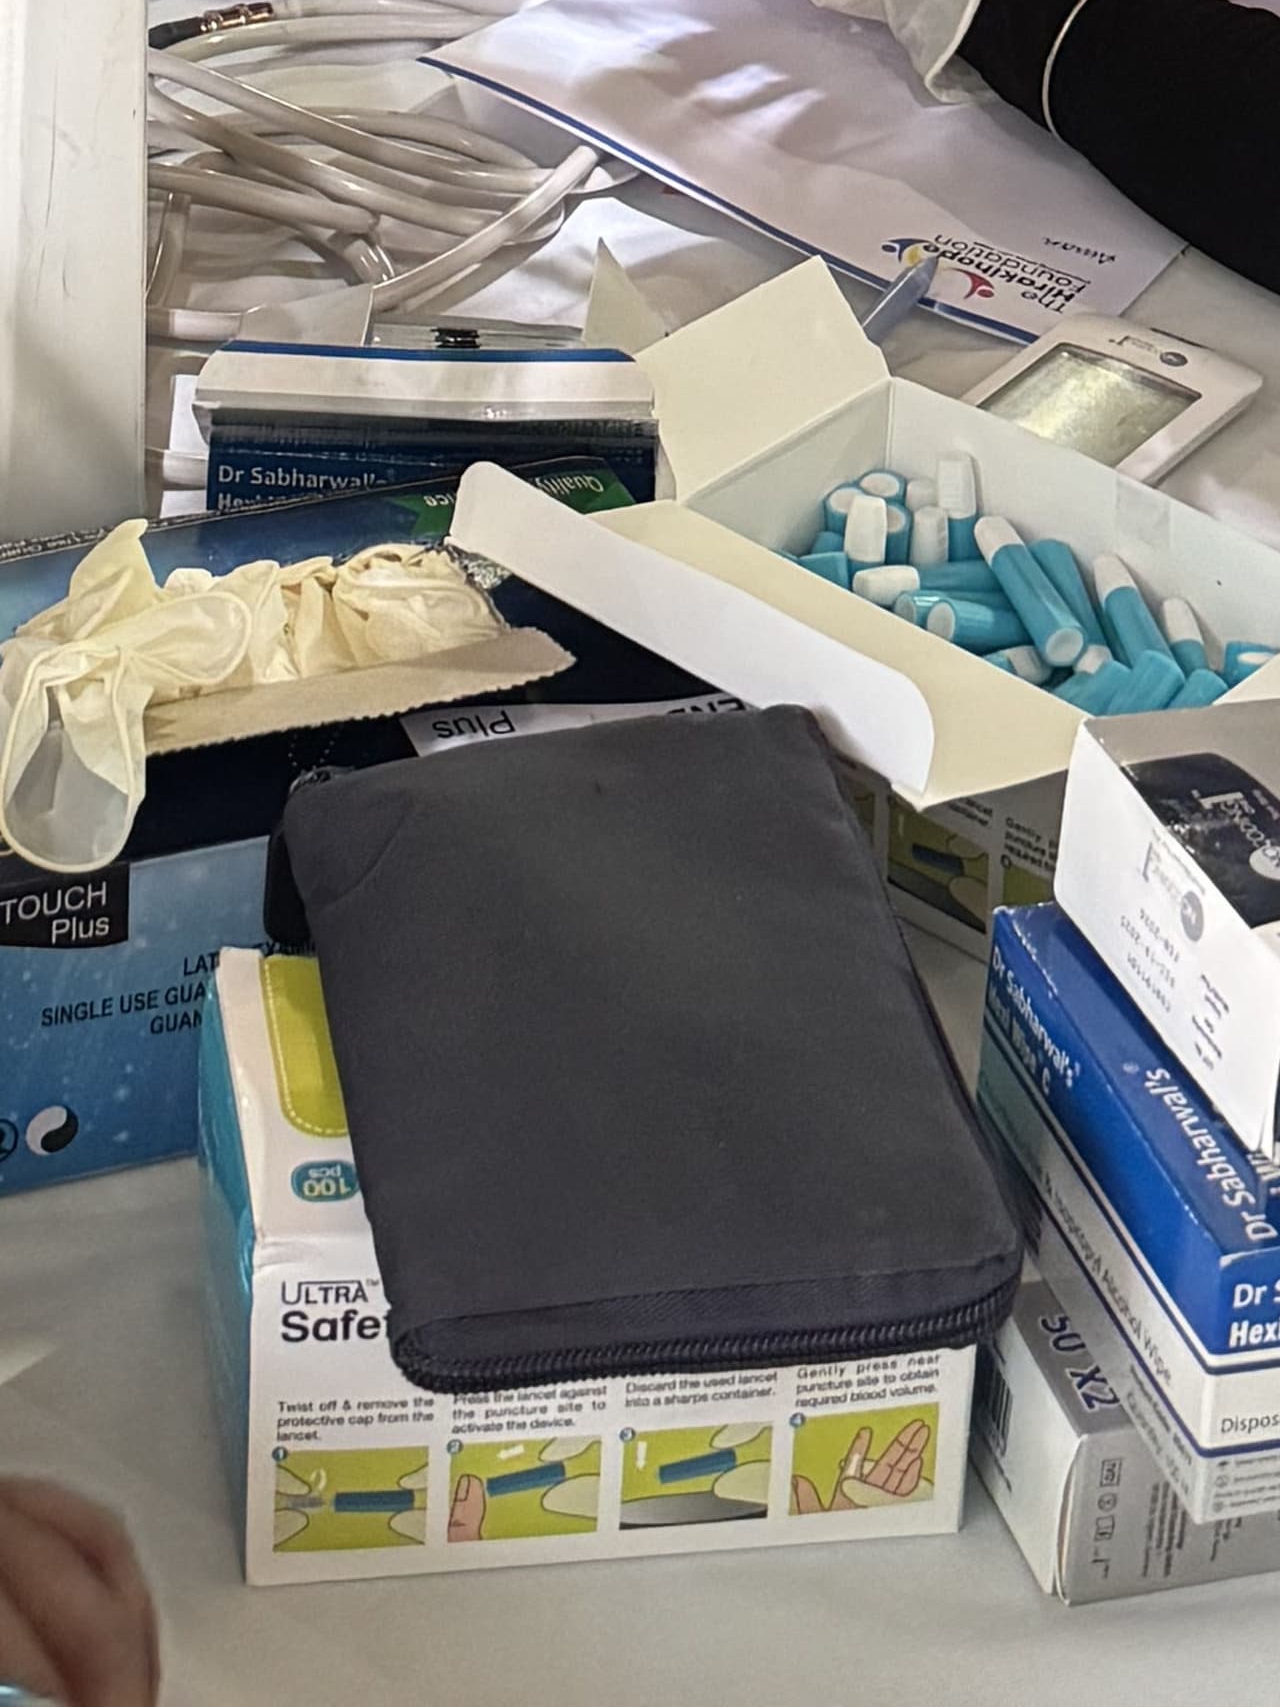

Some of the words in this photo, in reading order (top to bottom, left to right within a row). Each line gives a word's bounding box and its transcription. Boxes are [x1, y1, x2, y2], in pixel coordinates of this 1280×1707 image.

[934, 234, 1087, 293] Foundation
[1021, 291, 1066, 314] The
[218, 465, 244, 484] Dr
[431, 709, 515, 740] Plus
[0, 881, 107, 925] TOUCH
[51, 916, 110, 945] Plus
[41, 994, 113, 1027] SINGLE
[118, 991, 159, 1015] USE
[307, 1164, 342, 1178] pcs
[303, 1177, 352, 1197] 100
[1244, 1209, 1278, 1242] Dr
[1232, 1283, 1267, 1309] Dr
[797, 1365, 846, 1379] Gently
[856, 1359, 898, 1374] press
[907, 1355, 940, 1367] near
[680, 1377, 701, 1390] the
[704, 1374, 736, 1388] used
[738, 1371, 778, 1386] lancet
[795, 1377, 853, 1395] puncture
[857, 1376, 880, 1388] site
[883, 1375, 897, 1385] to
[899, 1368, 939, 1383] obtain
[493, 1390, 514, 1402] the
[518, 1388, 556, 1401] lancet
[559, 1385, 607, 1401] against
[653, 1395, 661, 1405] a
[664, 1390, 709, 1406] sharps
[795, 1390, 848, 1408] required
[850, 1387, 887, 1402] blood
[278, 1400, 313, 1413] Twist
[319, 1399, 337, 1411] off
[357, 1399, 408, 1411] remove
[413, 1396, 434, 1409] the
[452, 1408, 475, 1419] the
[484, 1404, 548, 1419] puncture
[558, 1402, 582, 1414] site
[592, 1400, 607, 1411] to
[277, 1413, 344, 1429] protective
[348, 1414, 374, 1427] cap
[378, 1412, 409, 1424] from
[412, 1410, 434, 1422] the
[452, 1421, 503, 1434] activate
[506, 1419, 527, 1431] the
